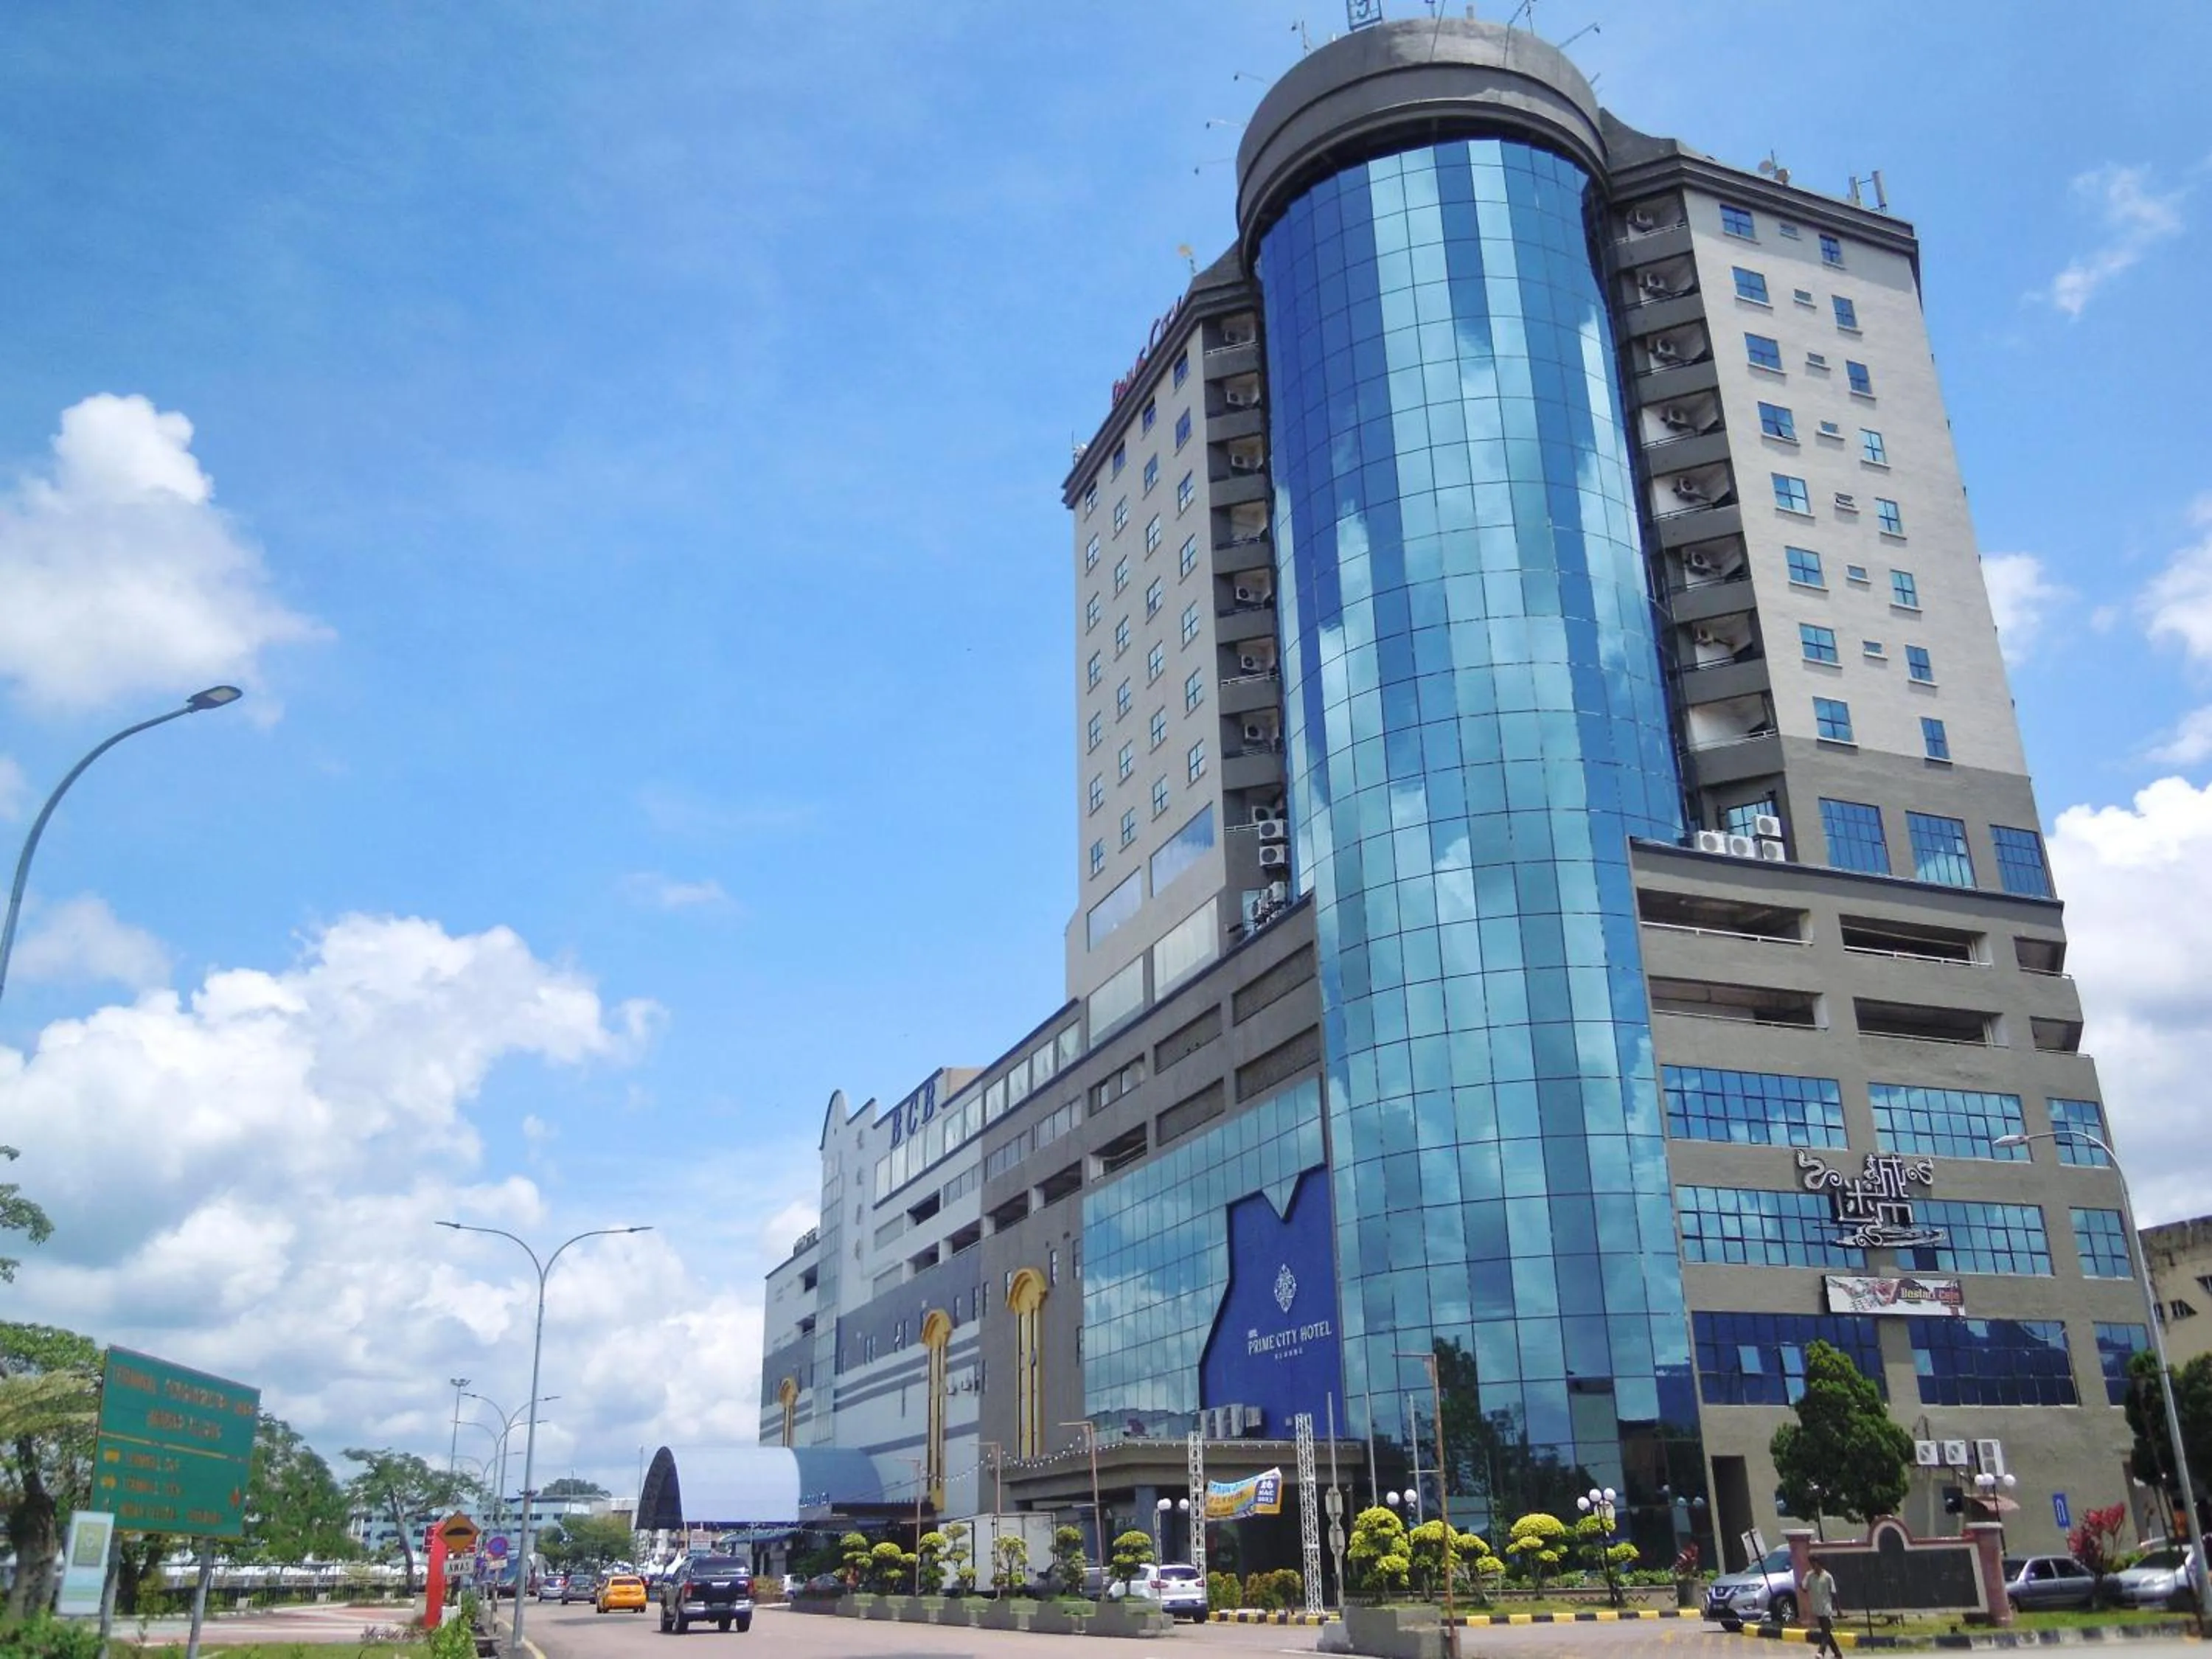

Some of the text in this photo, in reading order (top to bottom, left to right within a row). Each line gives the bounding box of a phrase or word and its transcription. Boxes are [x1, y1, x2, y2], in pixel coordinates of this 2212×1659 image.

[890, 1079, 936, 1150] BCB
[1248, 1335, 1275, 1356] PRIME
[1276, 1329, 1297, 1348] CITY
[1300, 1321, 1332, 1343] HOTEL
[448, 1561, 470, 1573] AWAS
